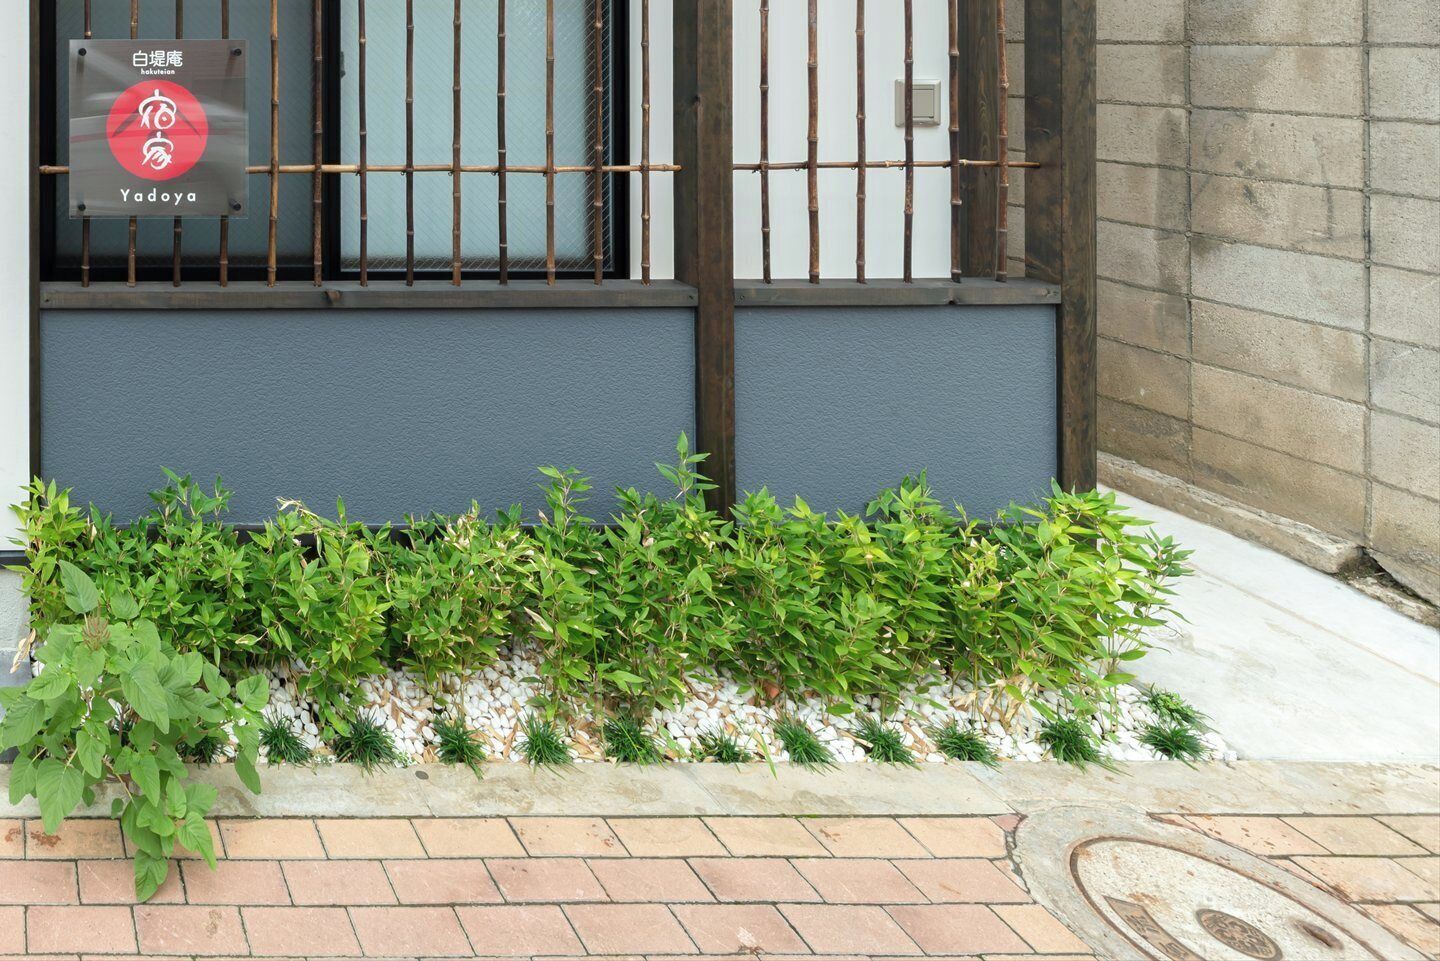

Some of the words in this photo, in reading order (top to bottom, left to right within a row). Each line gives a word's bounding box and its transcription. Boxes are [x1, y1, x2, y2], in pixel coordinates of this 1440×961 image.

[132, 50, 184, 67] 白堤庵
[120, 188, 197, 206] Yadoya
